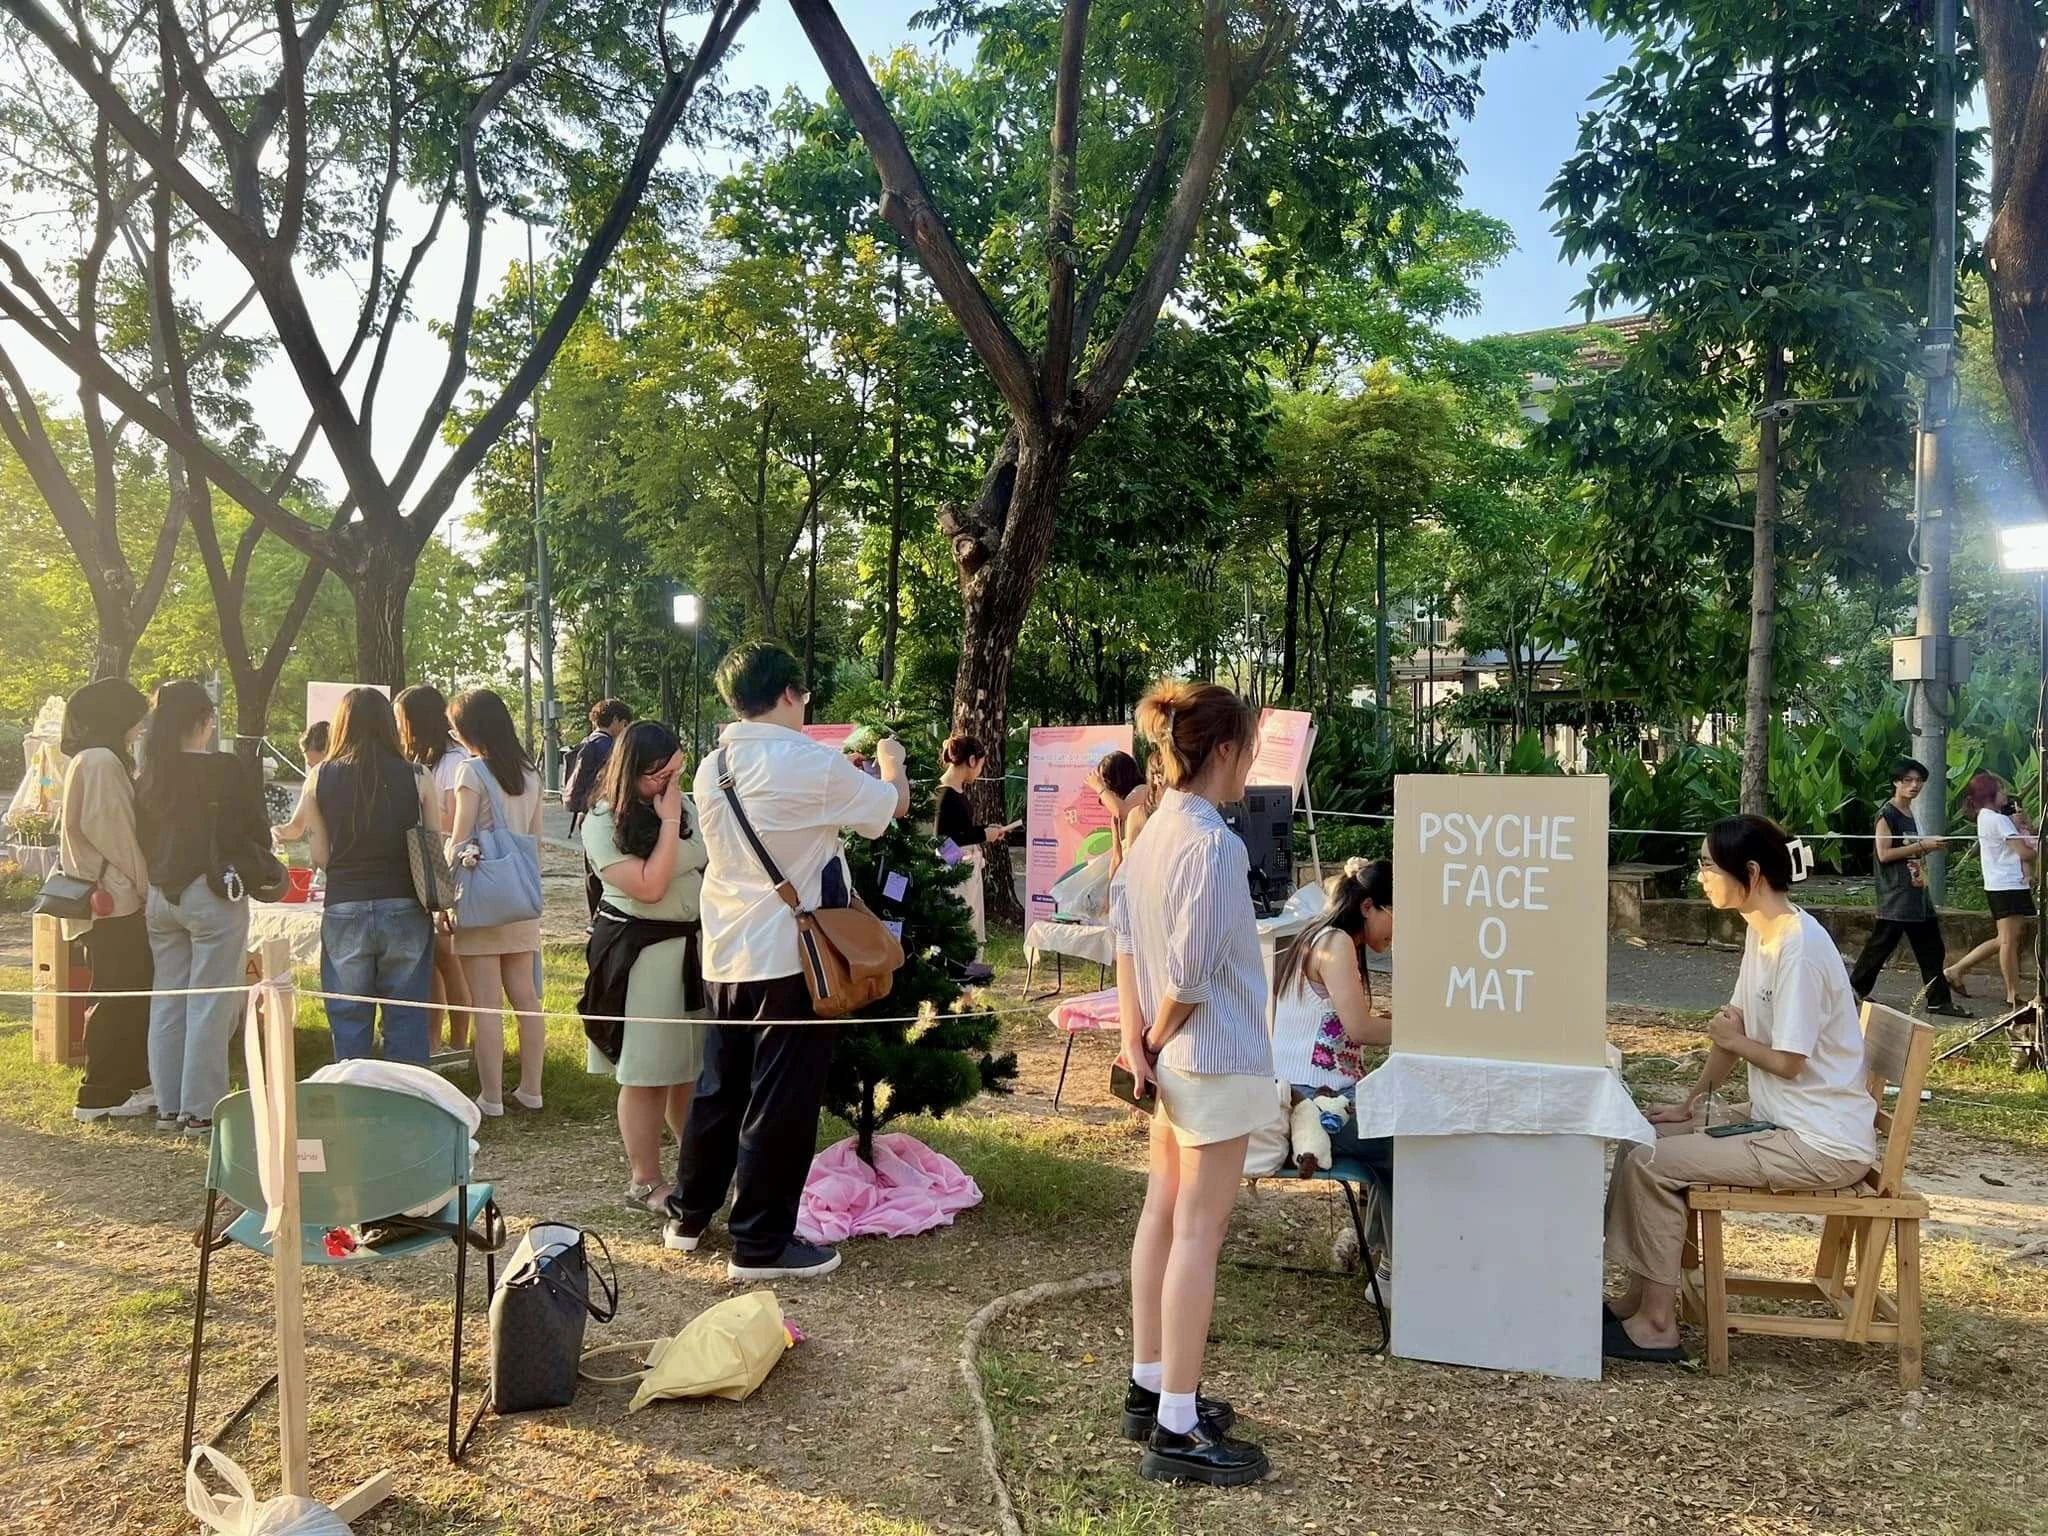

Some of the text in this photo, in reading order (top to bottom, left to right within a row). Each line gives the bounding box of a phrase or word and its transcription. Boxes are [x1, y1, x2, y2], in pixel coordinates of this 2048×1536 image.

[1418, 811, 1577, 861] PSYCHE
[1442, 862, 1551, 911] FACE
[1478, 916, 1508, 960] O
[1445, 964, 1536, 1013] MAT
